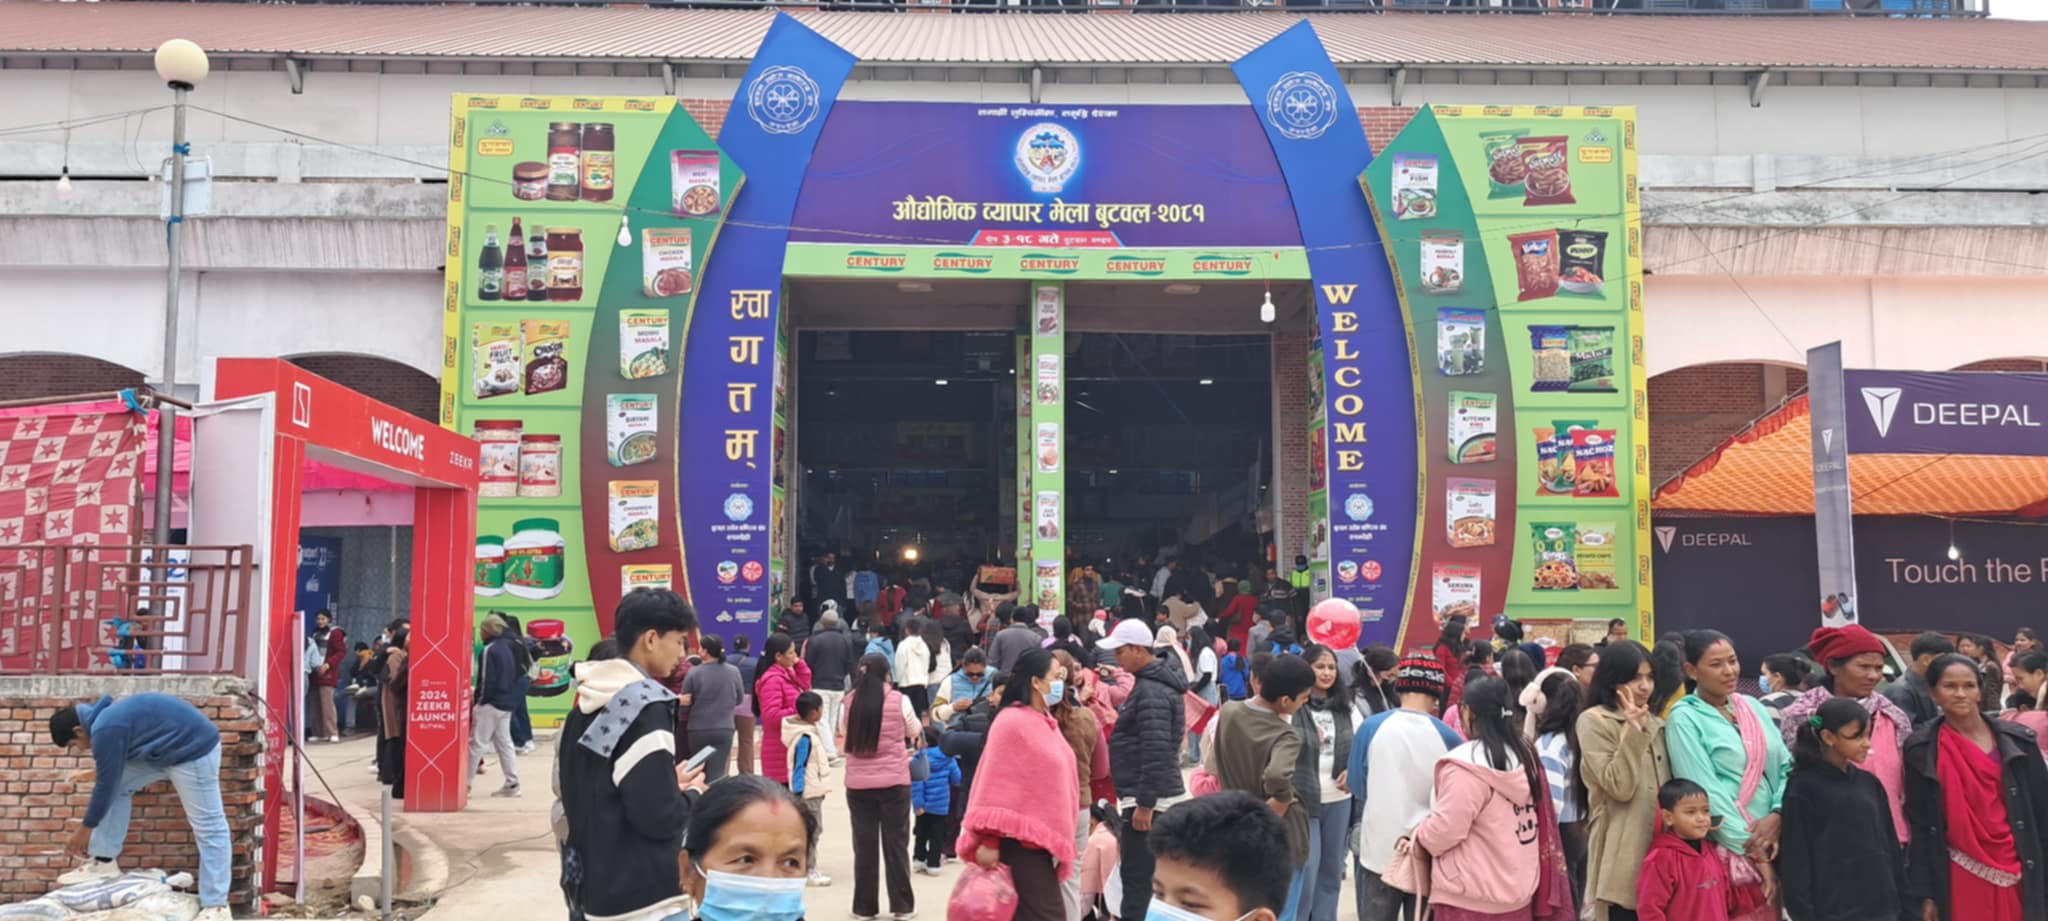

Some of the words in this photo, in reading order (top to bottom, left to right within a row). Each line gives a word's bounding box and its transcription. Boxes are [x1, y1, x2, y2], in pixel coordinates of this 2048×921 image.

[892, 194, 977, 222] औद्योगिक
[983, 202, 1043, 222] व्यापार
[1049, 197, 1089, 222] मेला
[650, 236, 690, 244] CENTURY
[846, 256, 906, 267] CENTURY
[933, 257, 992, 268] CENTURY
[1020, 258, 1079, 270] CENTURY
[1106, 261, 1165, 271] CENTURY
[1192, 261, 1251, 270] CENTURY
[1575, 349, 1608, 361] Matar
[1320, 284, 1368, 471] WELCOME
[620, 401, 653, 409] CENTURY
[1913, 402, 2041, 427] DEEPAL
[371, 416, 425, 460] WELCOME
[1540, 446, 1558, 454] NAC
[449, 451, 473, 470] ZEEKR
[1815, 461, 1843, 473] DEEPAL
[621, 488, 655, 496] CENTURY
[1682, 533, 1752, 546] DEEPAL
[1885, 558, 1977, 584] Touch
[1984, 558, 2032, 583] the
[630, 573, 672, 582] CENTURY
[419, 690, 448, 700] 2024
[416, 701, 451, 711] ZEEKR
[410, 712, 456, 722] LAUNCH
